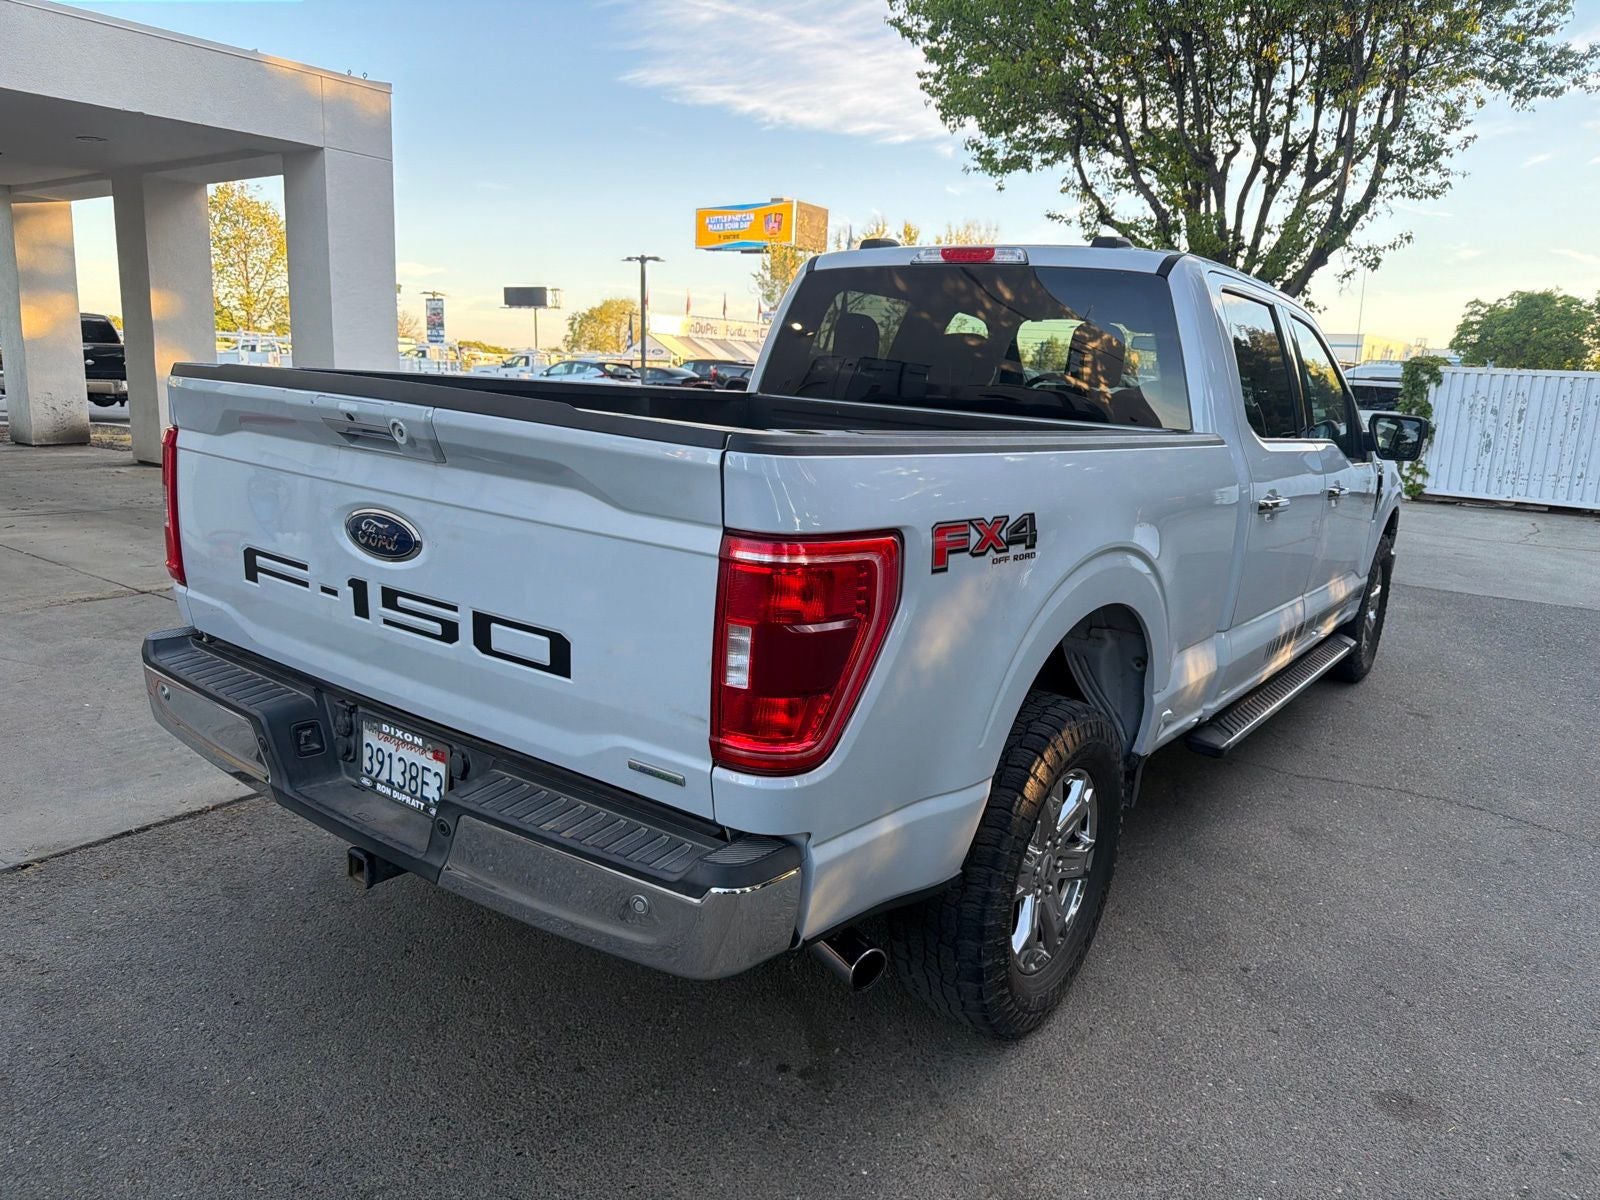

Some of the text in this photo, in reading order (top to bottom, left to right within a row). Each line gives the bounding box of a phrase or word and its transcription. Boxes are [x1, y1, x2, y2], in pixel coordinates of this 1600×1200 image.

[931, 512, 1037, 575] FX4
[992, 551, 1036, 565] OFF ROAD
[243, 547, 572, 679] F-150
[382, 724, 423, 746] DIXON
[364, 742, 443, 804] 39138E3
[376, 783, 425, 811] RON DUPRATT
